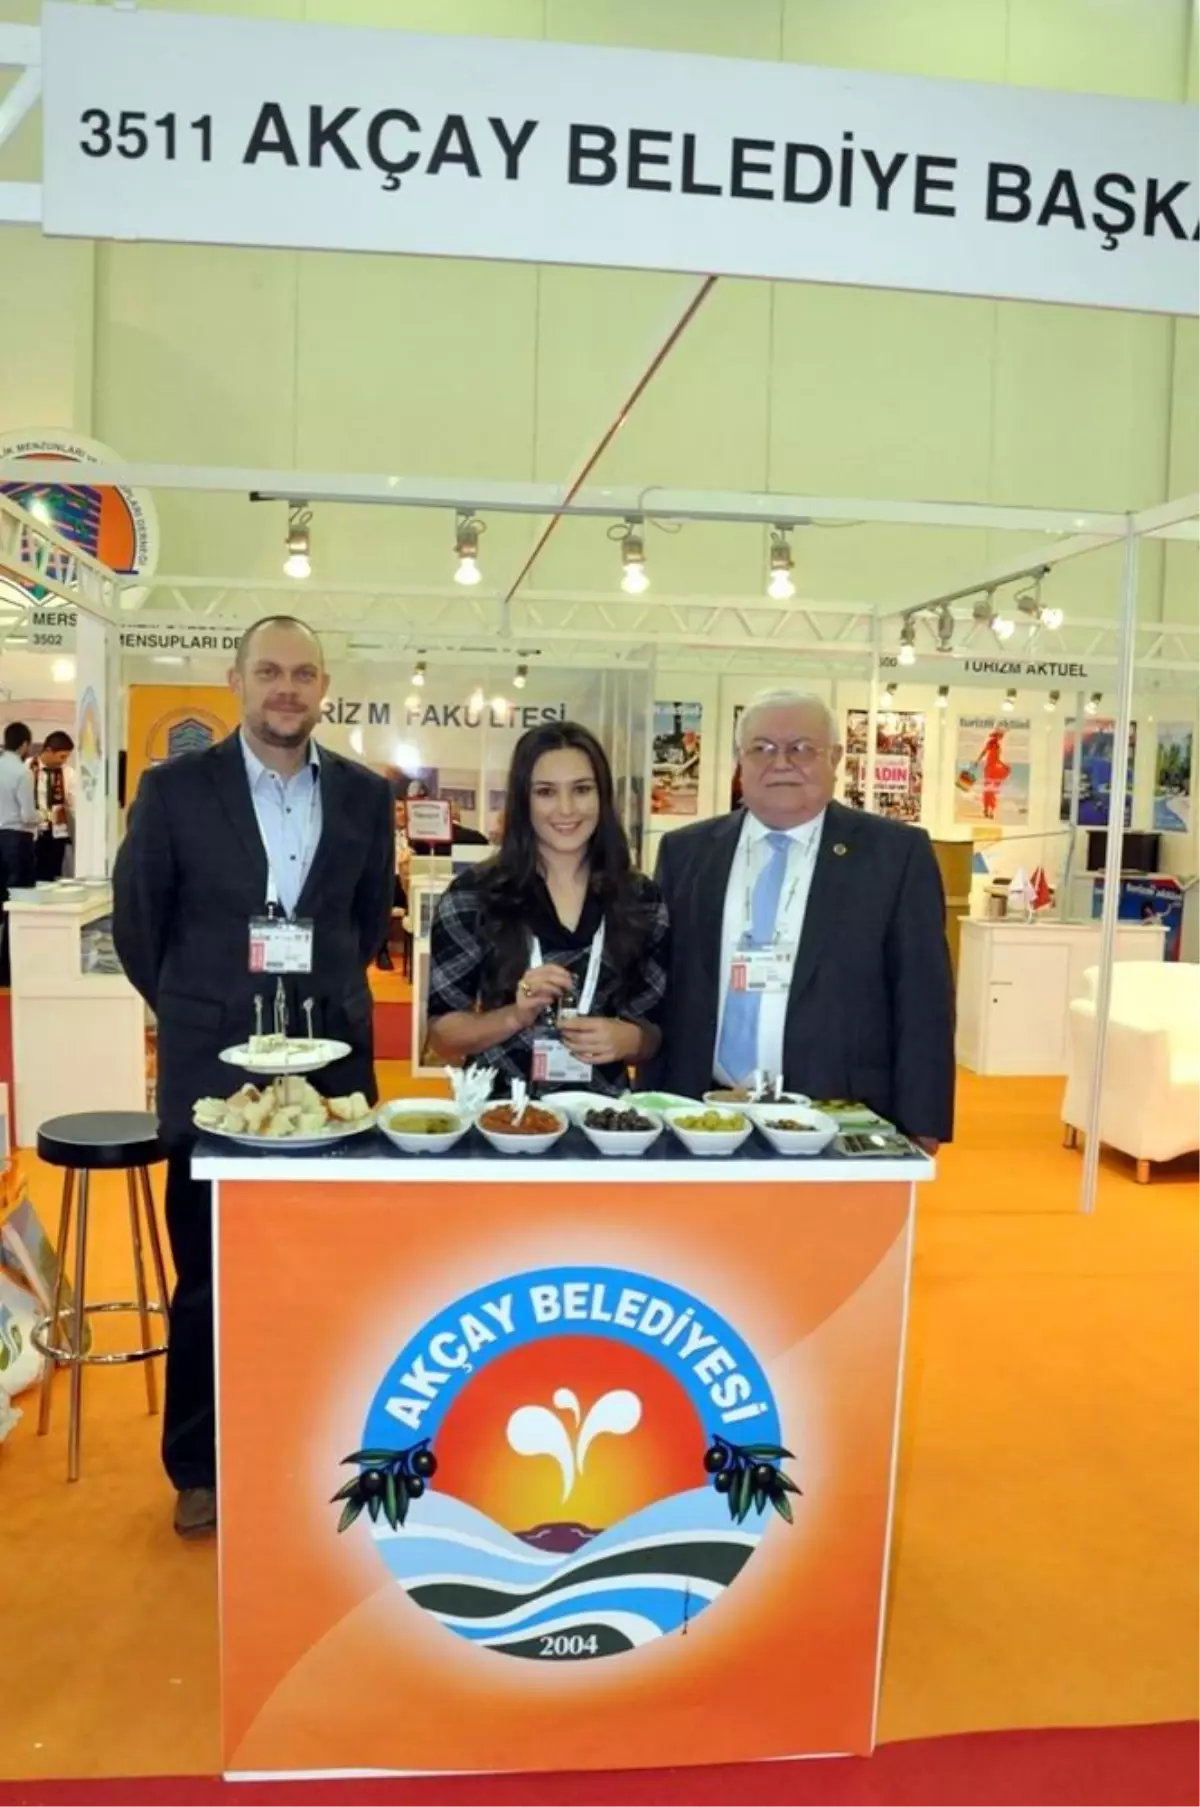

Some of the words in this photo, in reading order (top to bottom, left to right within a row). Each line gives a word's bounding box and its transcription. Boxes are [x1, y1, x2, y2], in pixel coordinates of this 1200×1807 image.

[79, 108, 213, 162] 3511
[242, 101, 539, 191] AKÇAY
[567, 123, 958, 217] BELEDİYE
[986, 161, 1200, 250] BAŞK
[31, 634, 63, 646] 3502
[384, 1293, 517, 1430] AKÇAY
[528, 1282, 769, 1425] BELEDİYESİ
[539, 1633, 599, 1657] 2004
